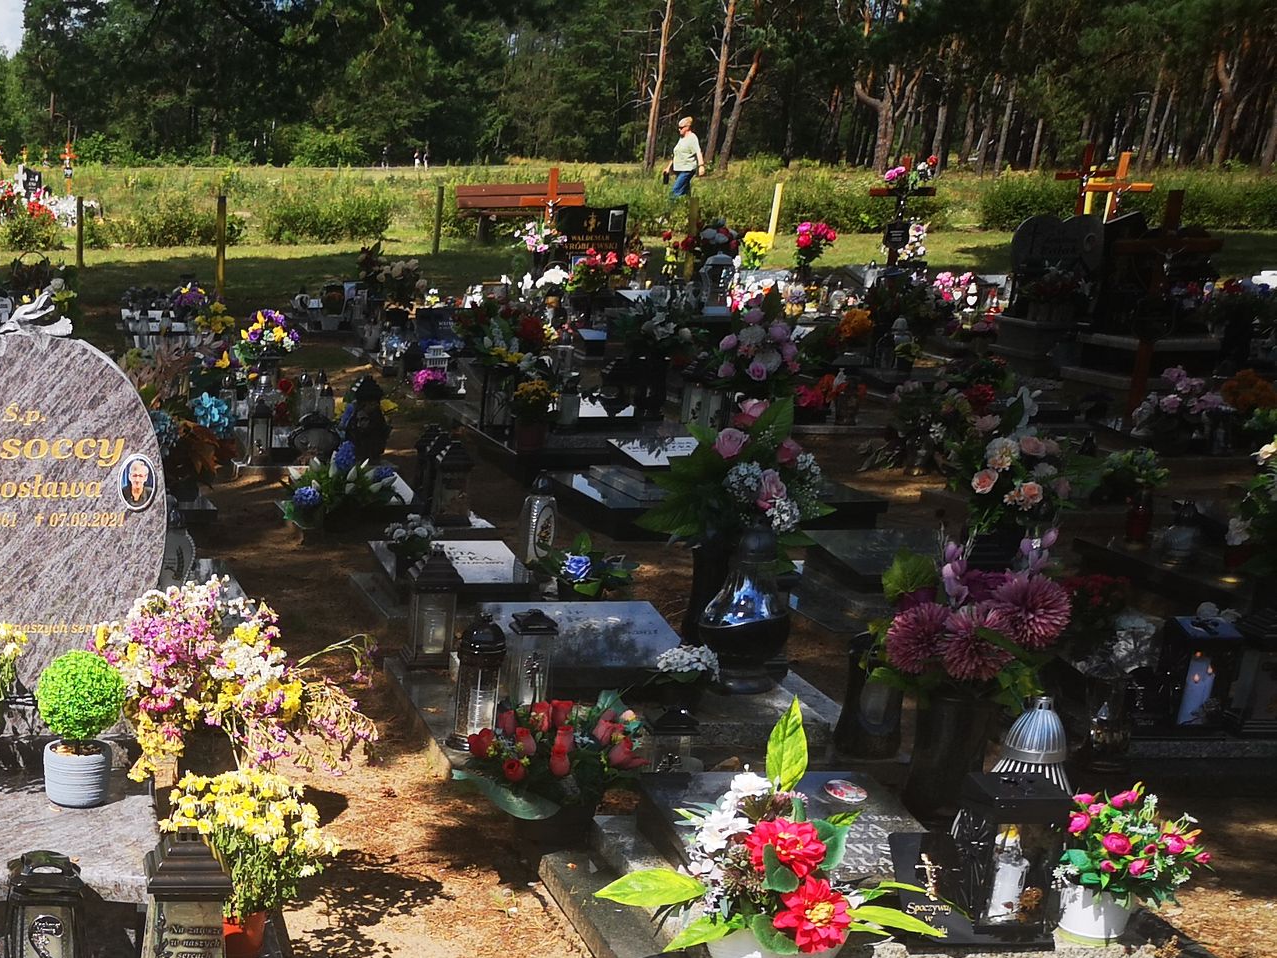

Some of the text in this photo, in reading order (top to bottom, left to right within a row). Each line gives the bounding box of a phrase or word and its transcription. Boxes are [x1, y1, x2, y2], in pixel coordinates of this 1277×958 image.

[3, 402, 47, 426] Ś.p.
[906, 902, 952, 915] Spoczywaj
[170, 925, 185, 934] Na
